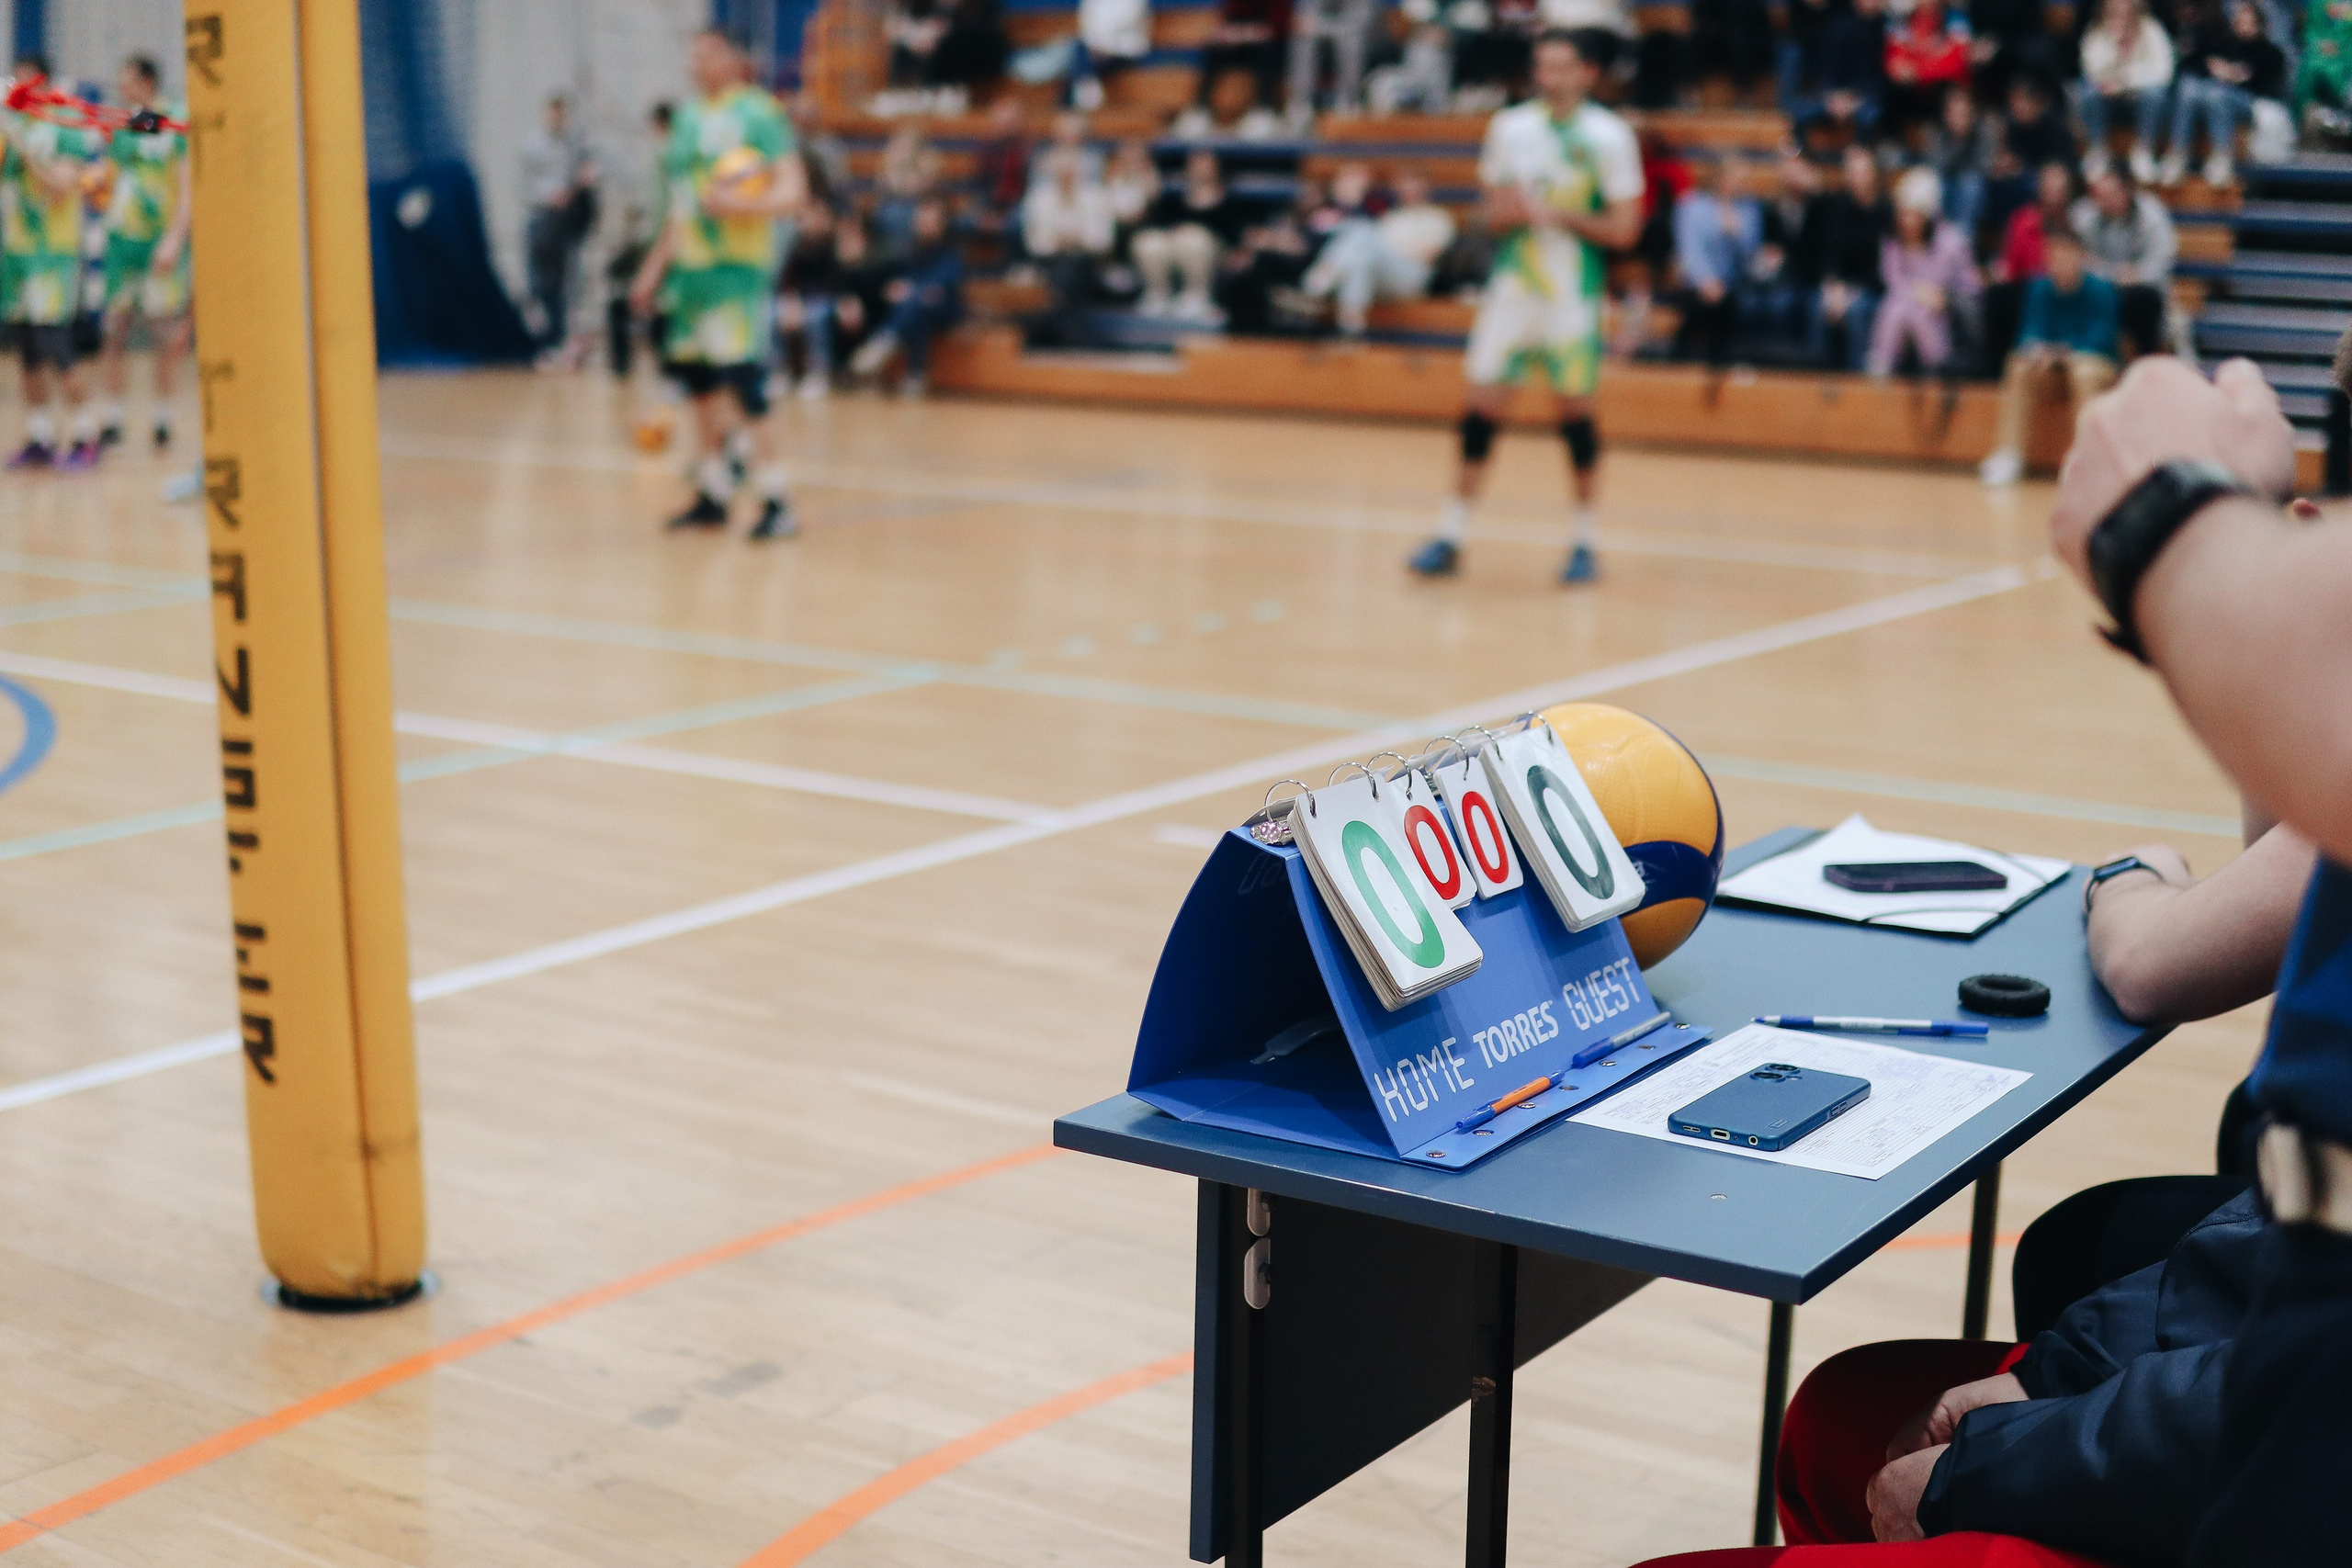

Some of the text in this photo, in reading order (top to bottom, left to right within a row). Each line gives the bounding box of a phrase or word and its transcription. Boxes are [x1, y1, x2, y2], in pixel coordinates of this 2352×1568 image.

[1341, 764, 1616, 969] 0 0 0 0
[1374, 956, 1642, 1122] HOME TORRES GUEST
